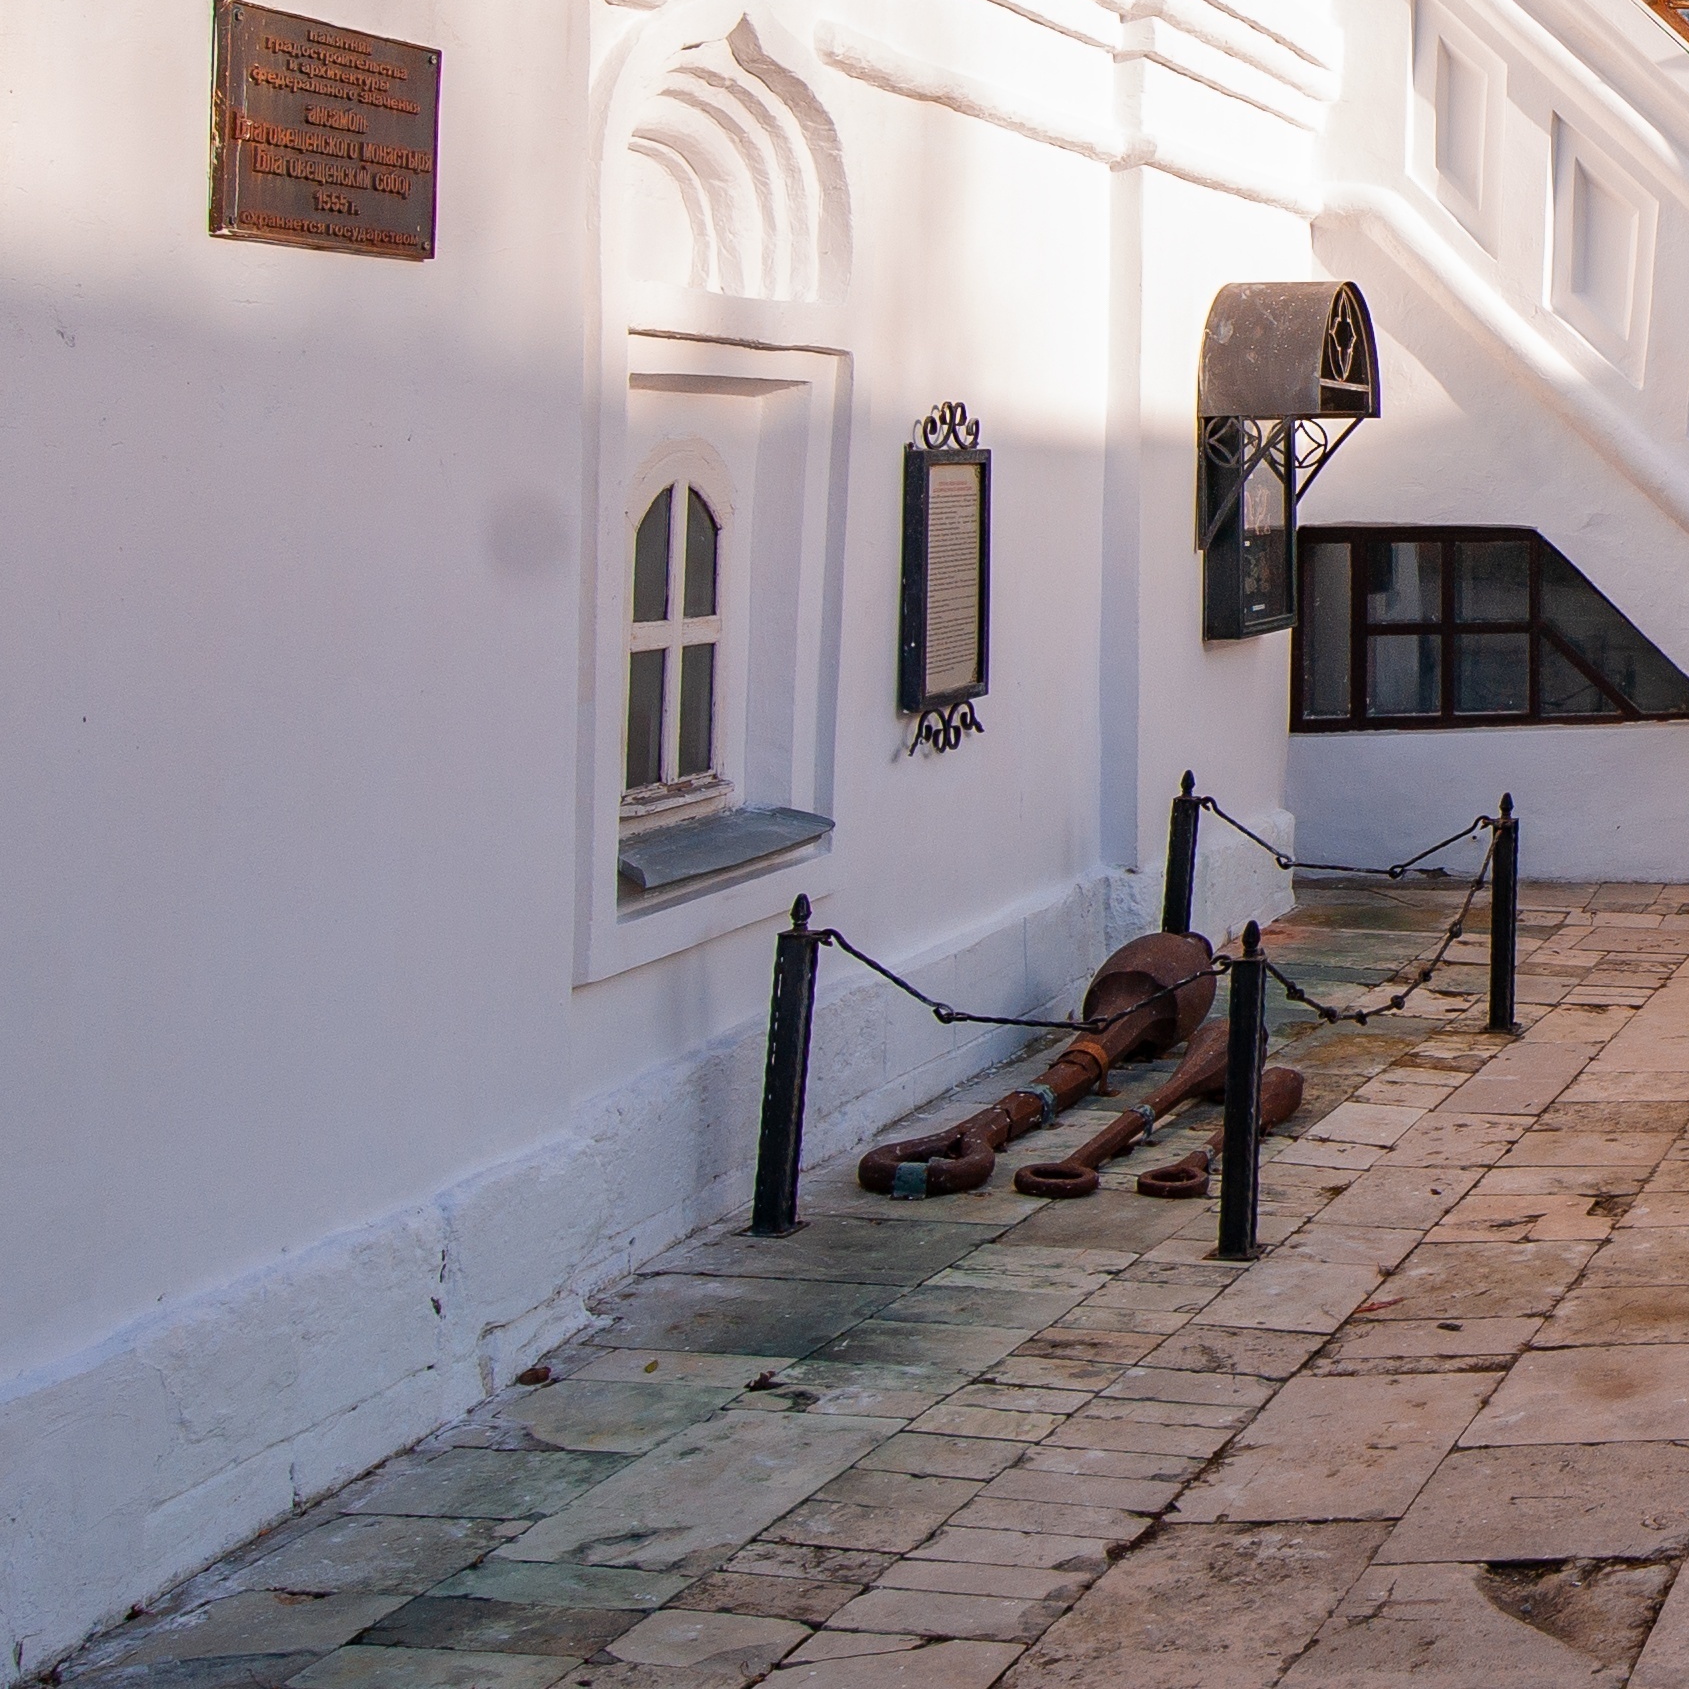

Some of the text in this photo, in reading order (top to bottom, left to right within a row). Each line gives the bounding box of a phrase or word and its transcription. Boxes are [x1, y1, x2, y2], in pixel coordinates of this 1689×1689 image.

[266, 37, 407, 80] градостроительства
[308, 30, 372, 55] памятник
[251, 65, 420, 114] федерального значения
[288, 57, 389, 92] и архитектуры
[306, 104, 369, 133] ансамбль
[234, 115, 432, 173] Благовещенского монастыря
[253, 147, 411, 198] Благовещенский собор
[316, 190, 360, 215] 1555 г.
[241, 210, 418, 247] охраняется государством
